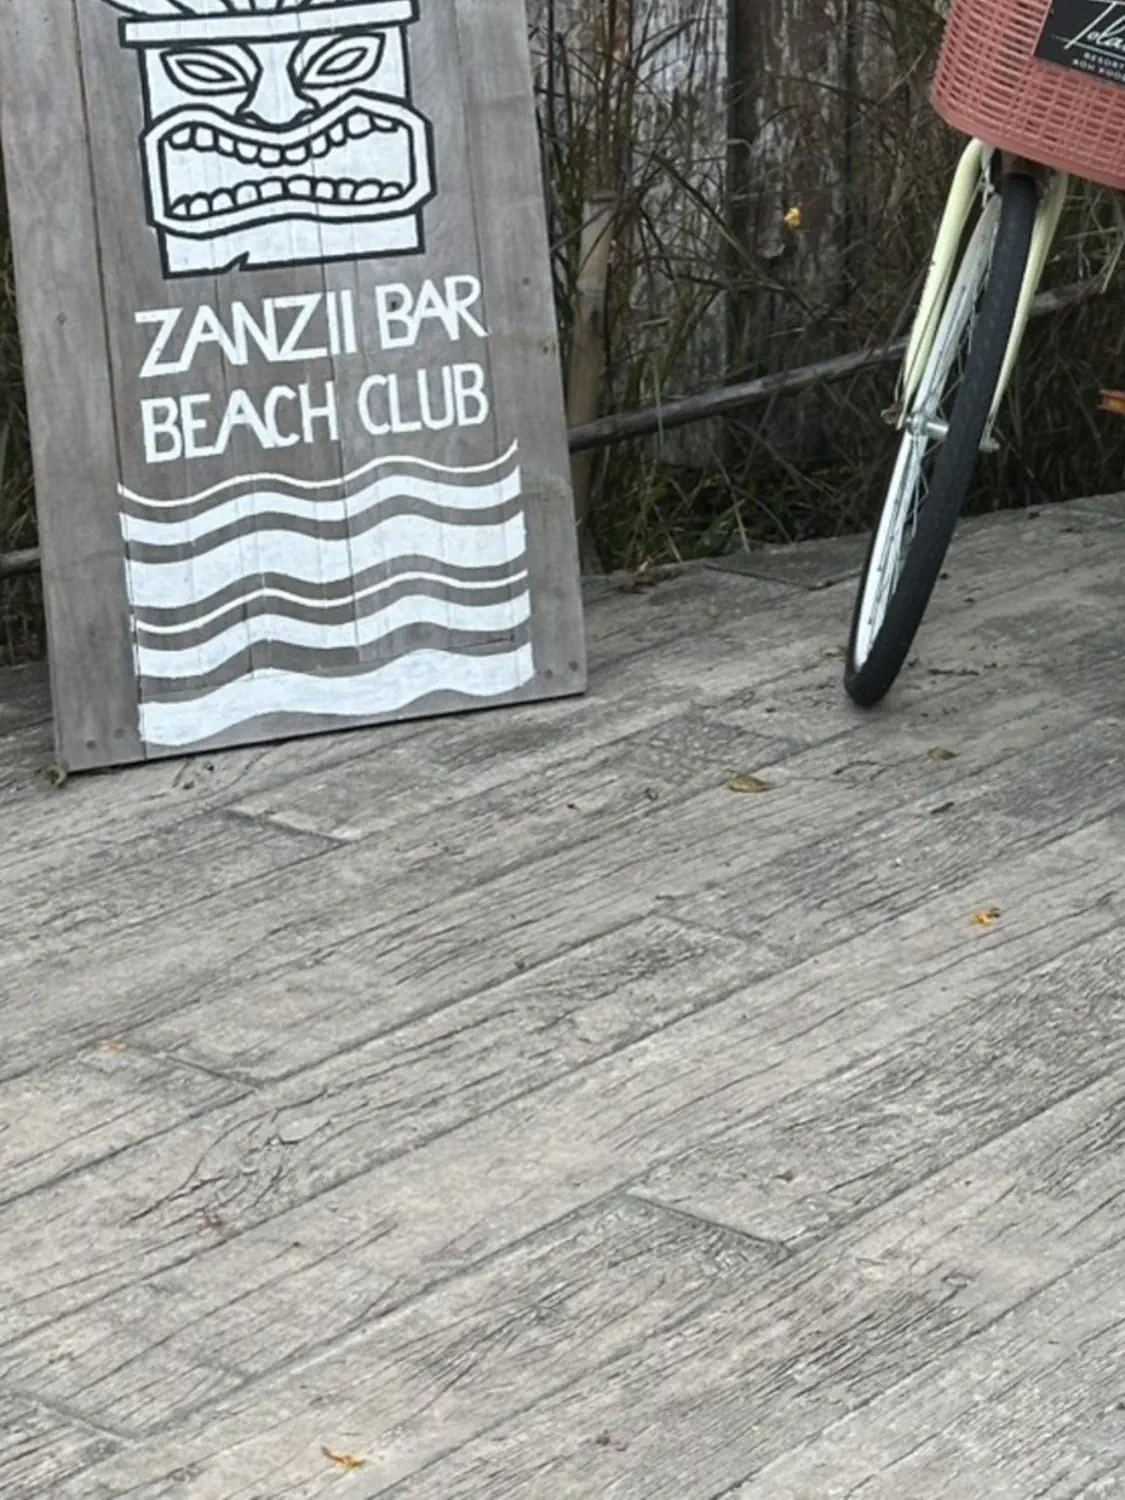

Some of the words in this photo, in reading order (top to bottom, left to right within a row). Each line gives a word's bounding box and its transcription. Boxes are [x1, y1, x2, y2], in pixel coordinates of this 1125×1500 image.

[1084, 52, 1125, 70] RESORT
[134, 289, 358, 378] ZANZII
[375, 274, 493, 350] BAR
[140, 380, 340, 464] BEACH
[357, 363, 490, 436] CLUB
